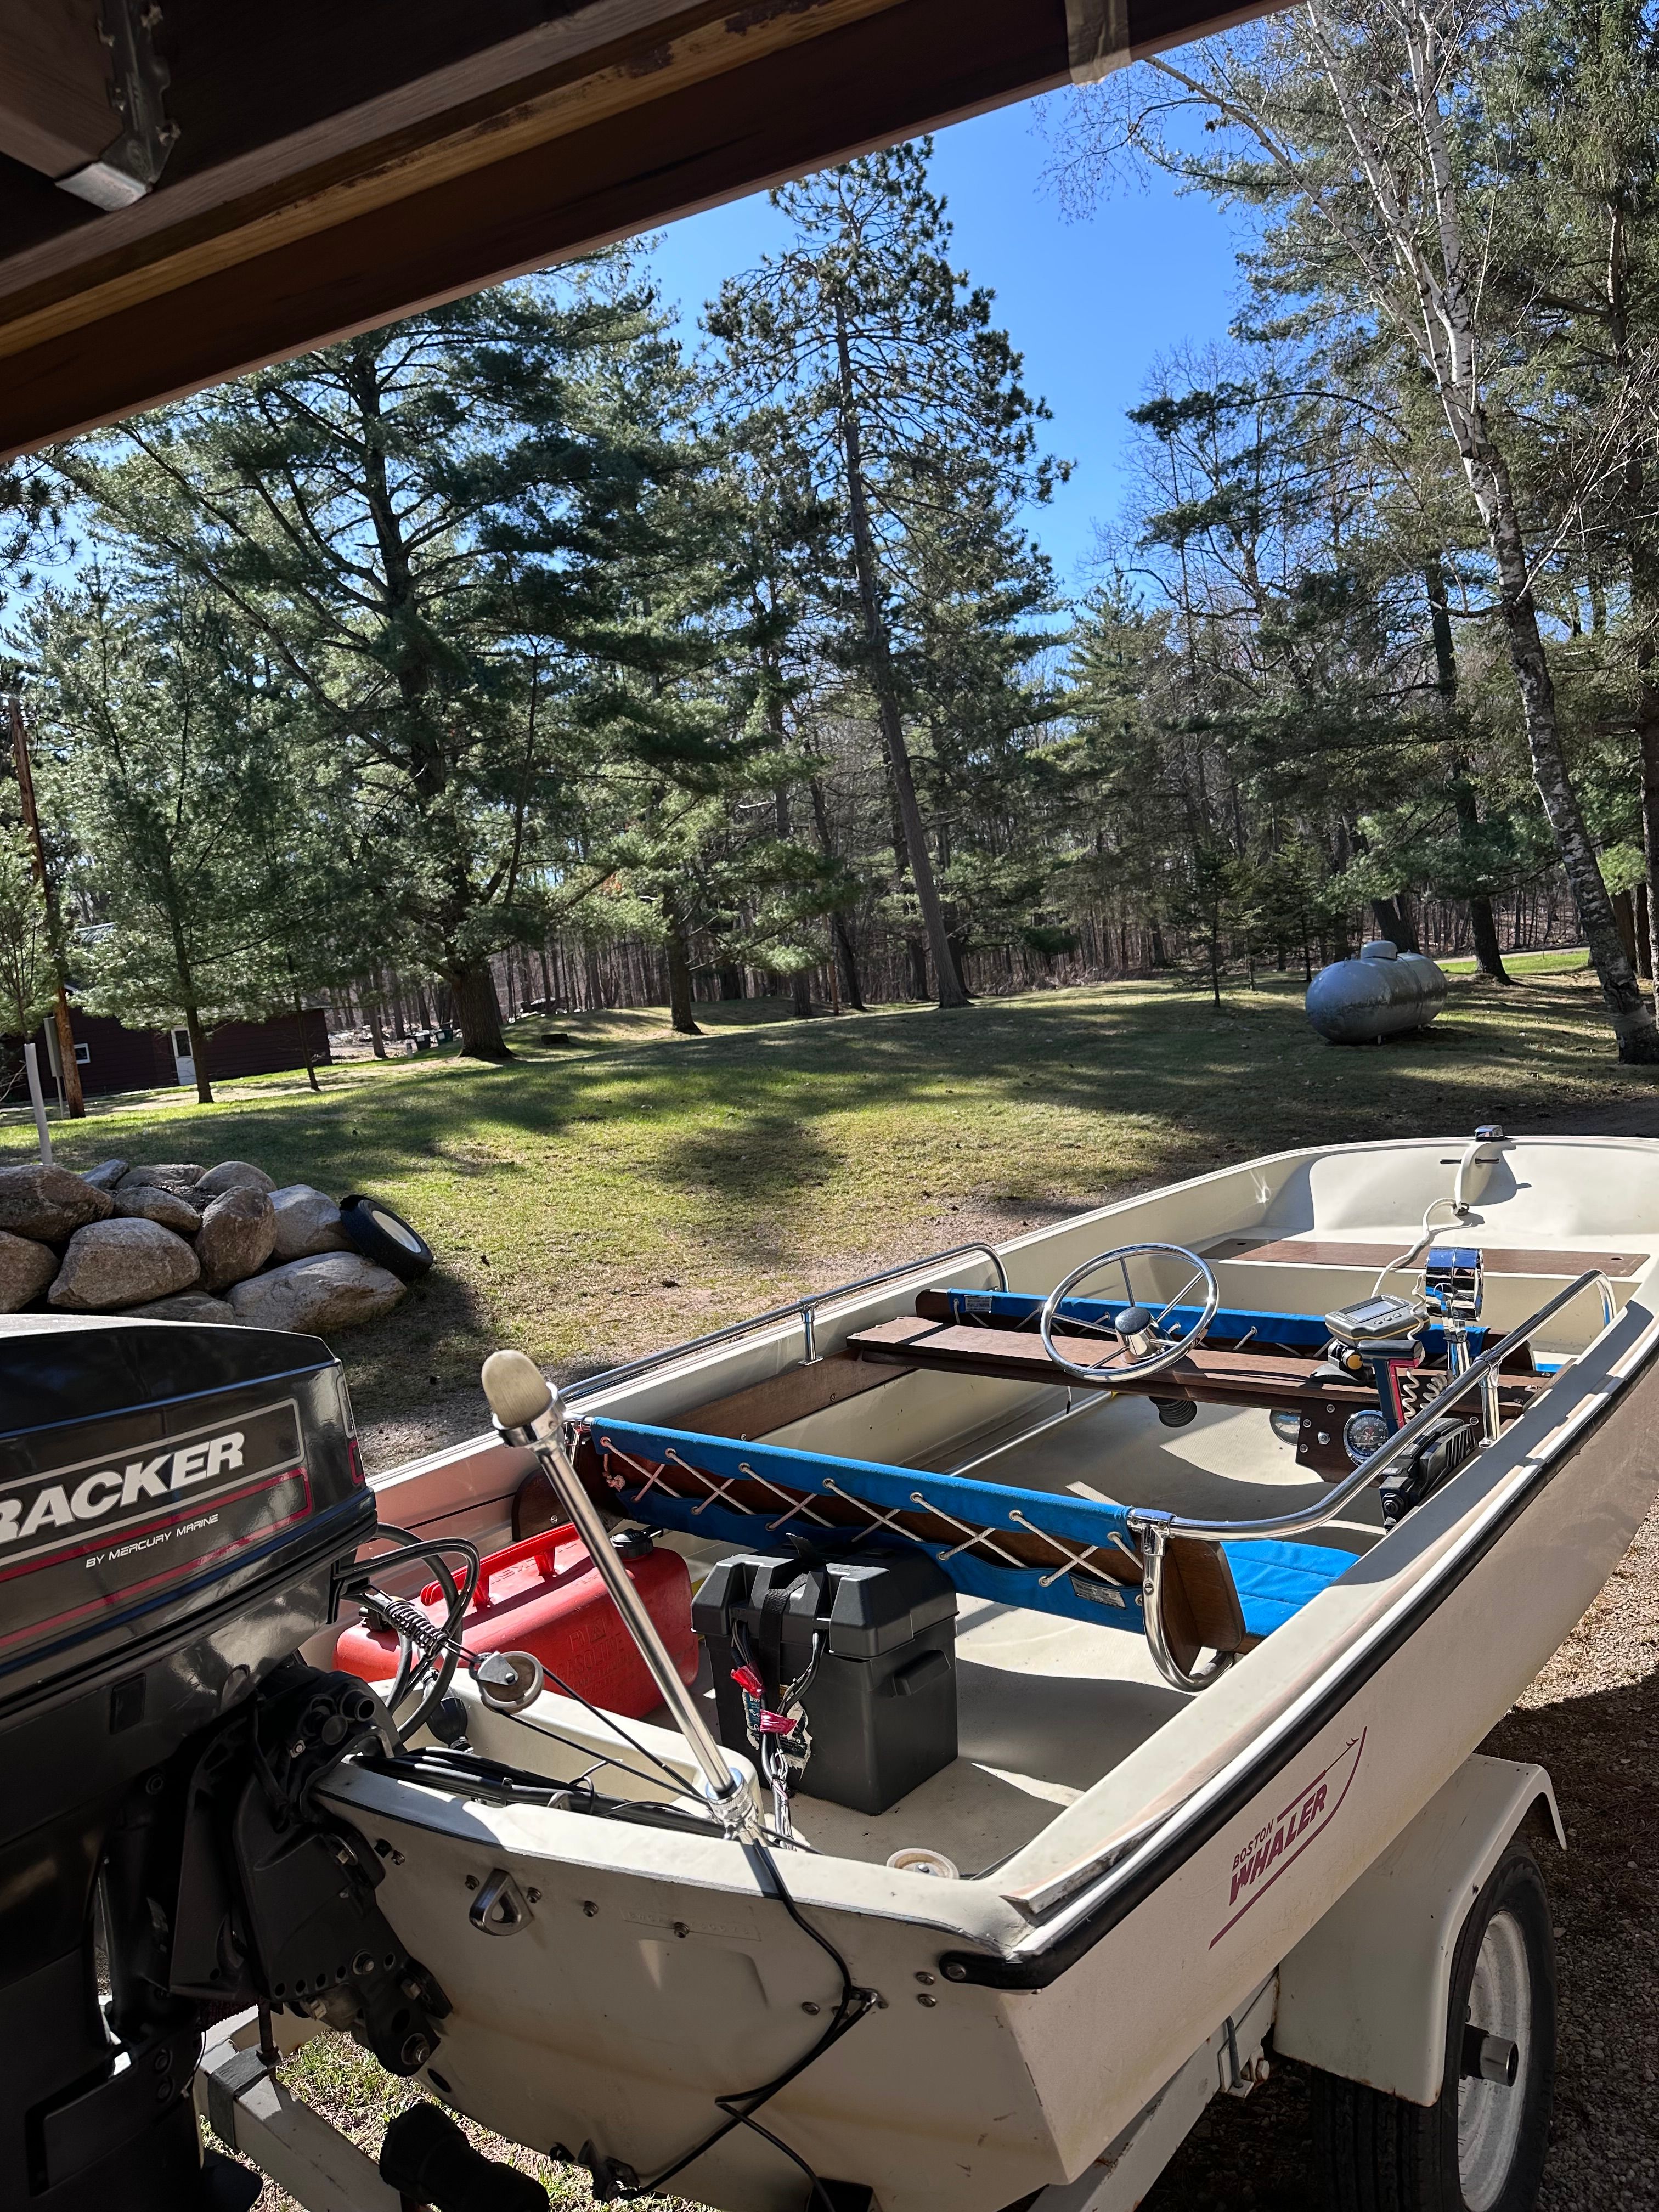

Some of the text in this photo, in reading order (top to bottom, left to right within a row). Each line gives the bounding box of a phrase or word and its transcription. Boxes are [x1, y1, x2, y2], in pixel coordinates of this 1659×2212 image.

[86, 1513, 219, 1568] BY MERCURY MARINE
[1229, 1784, 1328, 1906] WHALER
[1232, 1818, 1274, 1872] BOSTON
